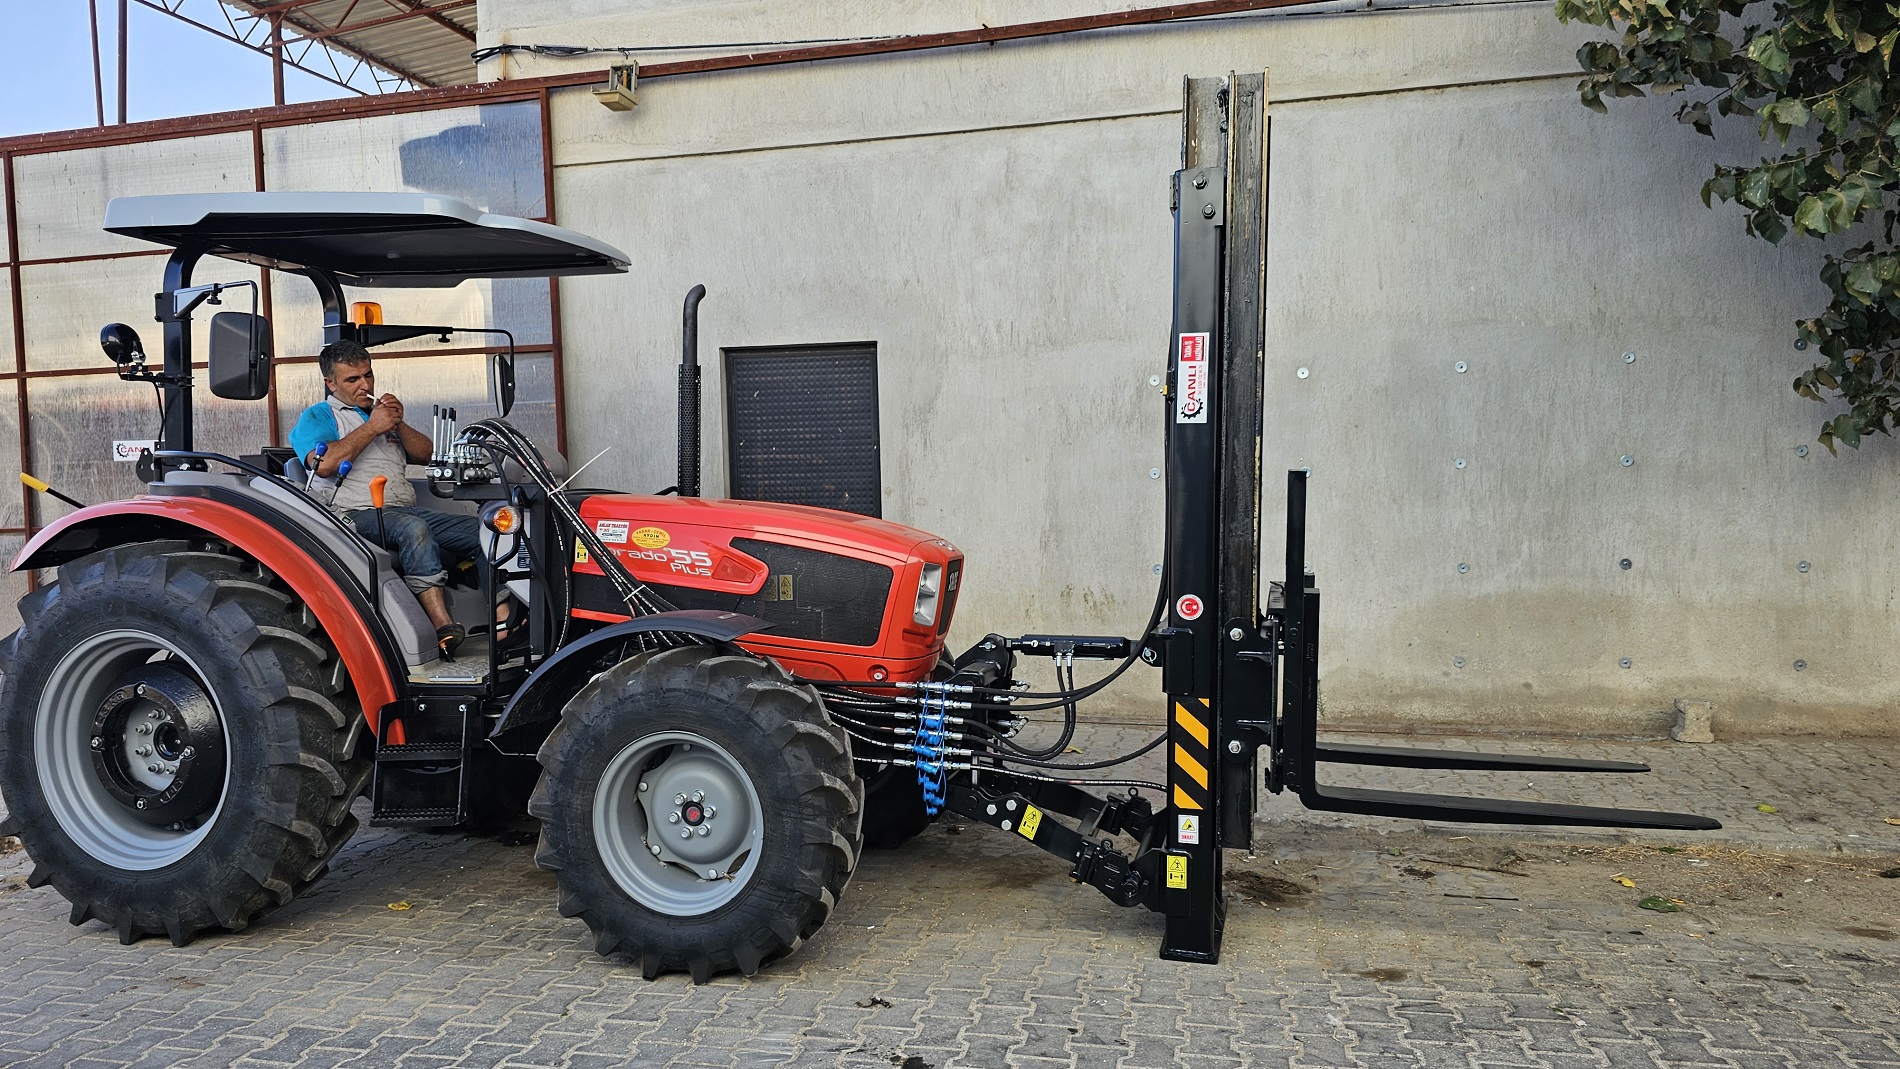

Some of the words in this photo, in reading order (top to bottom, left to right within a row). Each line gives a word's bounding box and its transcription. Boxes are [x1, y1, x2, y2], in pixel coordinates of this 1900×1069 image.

[1187, 365, 1197, 412] CANLI
[608, 548, 667, 562] orado
[670, 562, 711, 576] Plus
